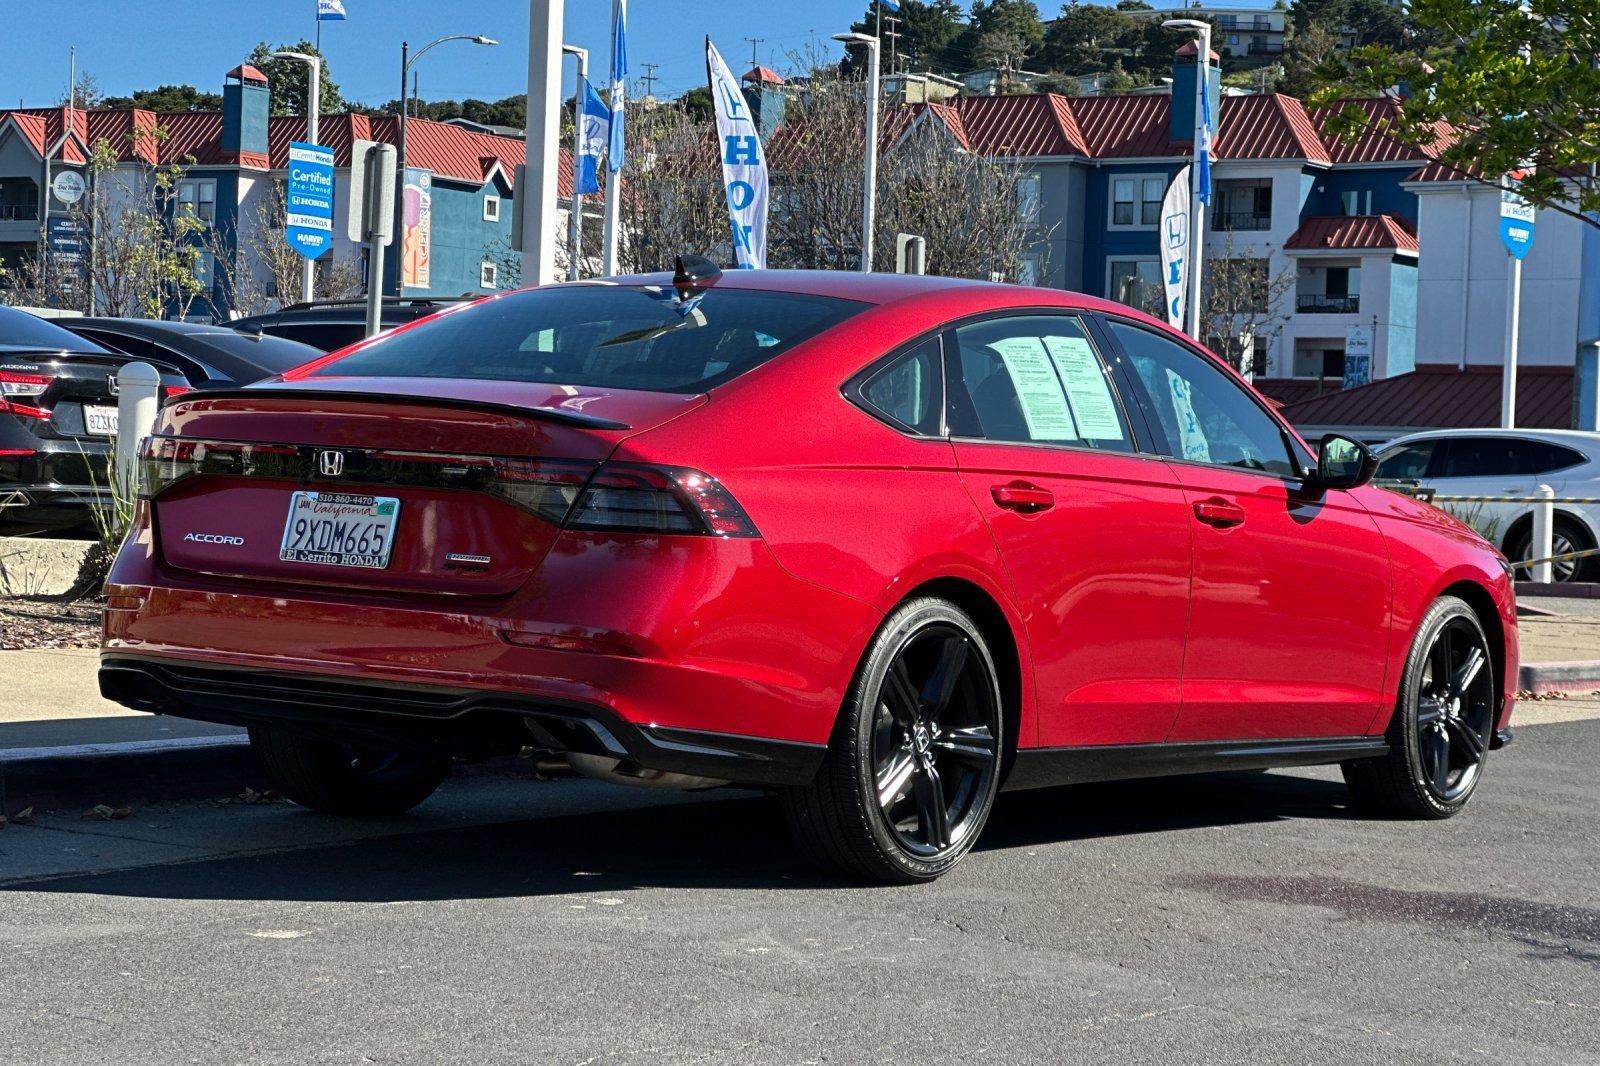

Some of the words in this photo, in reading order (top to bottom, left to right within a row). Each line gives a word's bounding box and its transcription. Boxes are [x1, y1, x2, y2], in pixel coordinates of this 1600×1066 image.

[292, 169, 330, 186] Certified
[292, 182, 330, 194] Pre-Owned
[301, 198, 329, 208] HONDA
[300, 218, 328, 227] HONDA
[299, 500, 311, 510] JAN
[318, 493, 373, 505] 510-860-4470
[313, 502, 377, 519] California
[183, 532, 245, 546] ACCORD
[291, 519, 386, 555] 9XDM665
[286, 549, 298, 560] El
[300, 551, 338, 564] Cerrito
[341, 554, 380, 568] HONDA
